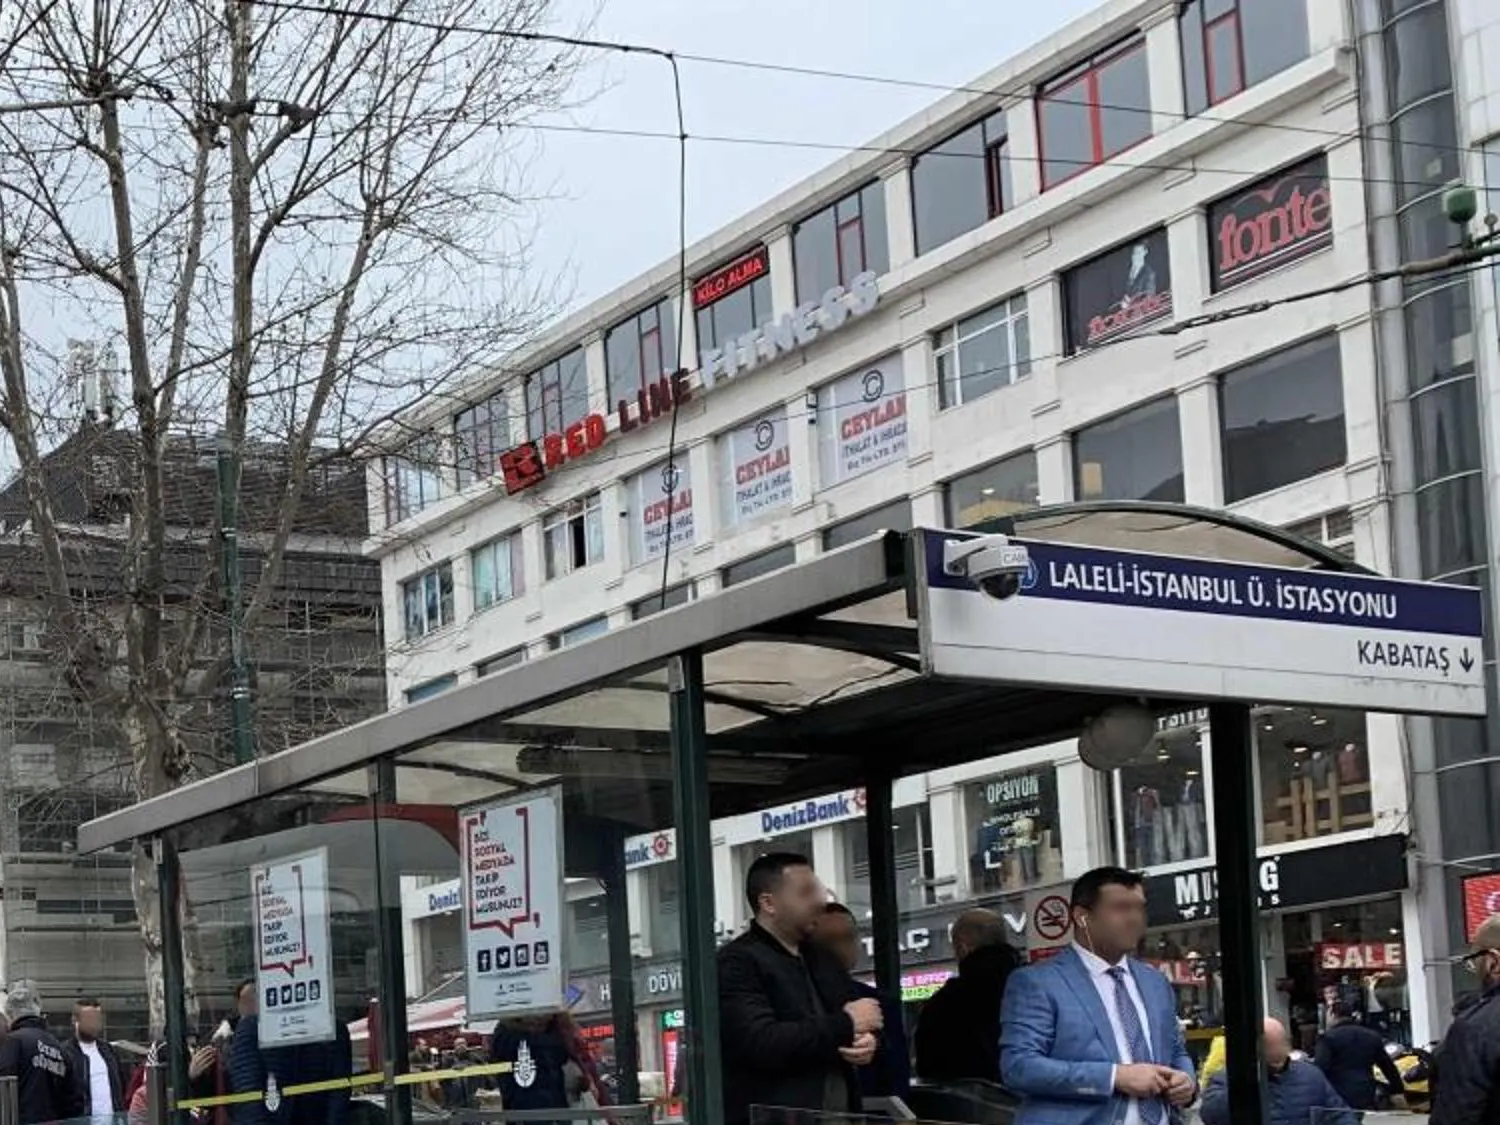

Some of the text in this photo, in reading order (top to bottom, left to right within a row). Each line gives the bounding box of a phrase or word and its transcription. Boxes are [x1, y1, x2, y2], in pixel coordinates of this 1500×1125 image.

[1218, 185, 1332, 270] fonte
[543, 269, 880, 469] RED LINE FITNESS
[1048, 560, 1398, 620] LALELİ-İSTANBUL Ü. İSTASYONU
[1356, 639, 1450, 678] KABATAŞ
[760, 798, 851, 834] DenizBank
[428, 883, 461, 912] Deniz
[1321, 943, 1402, 969] SALE
